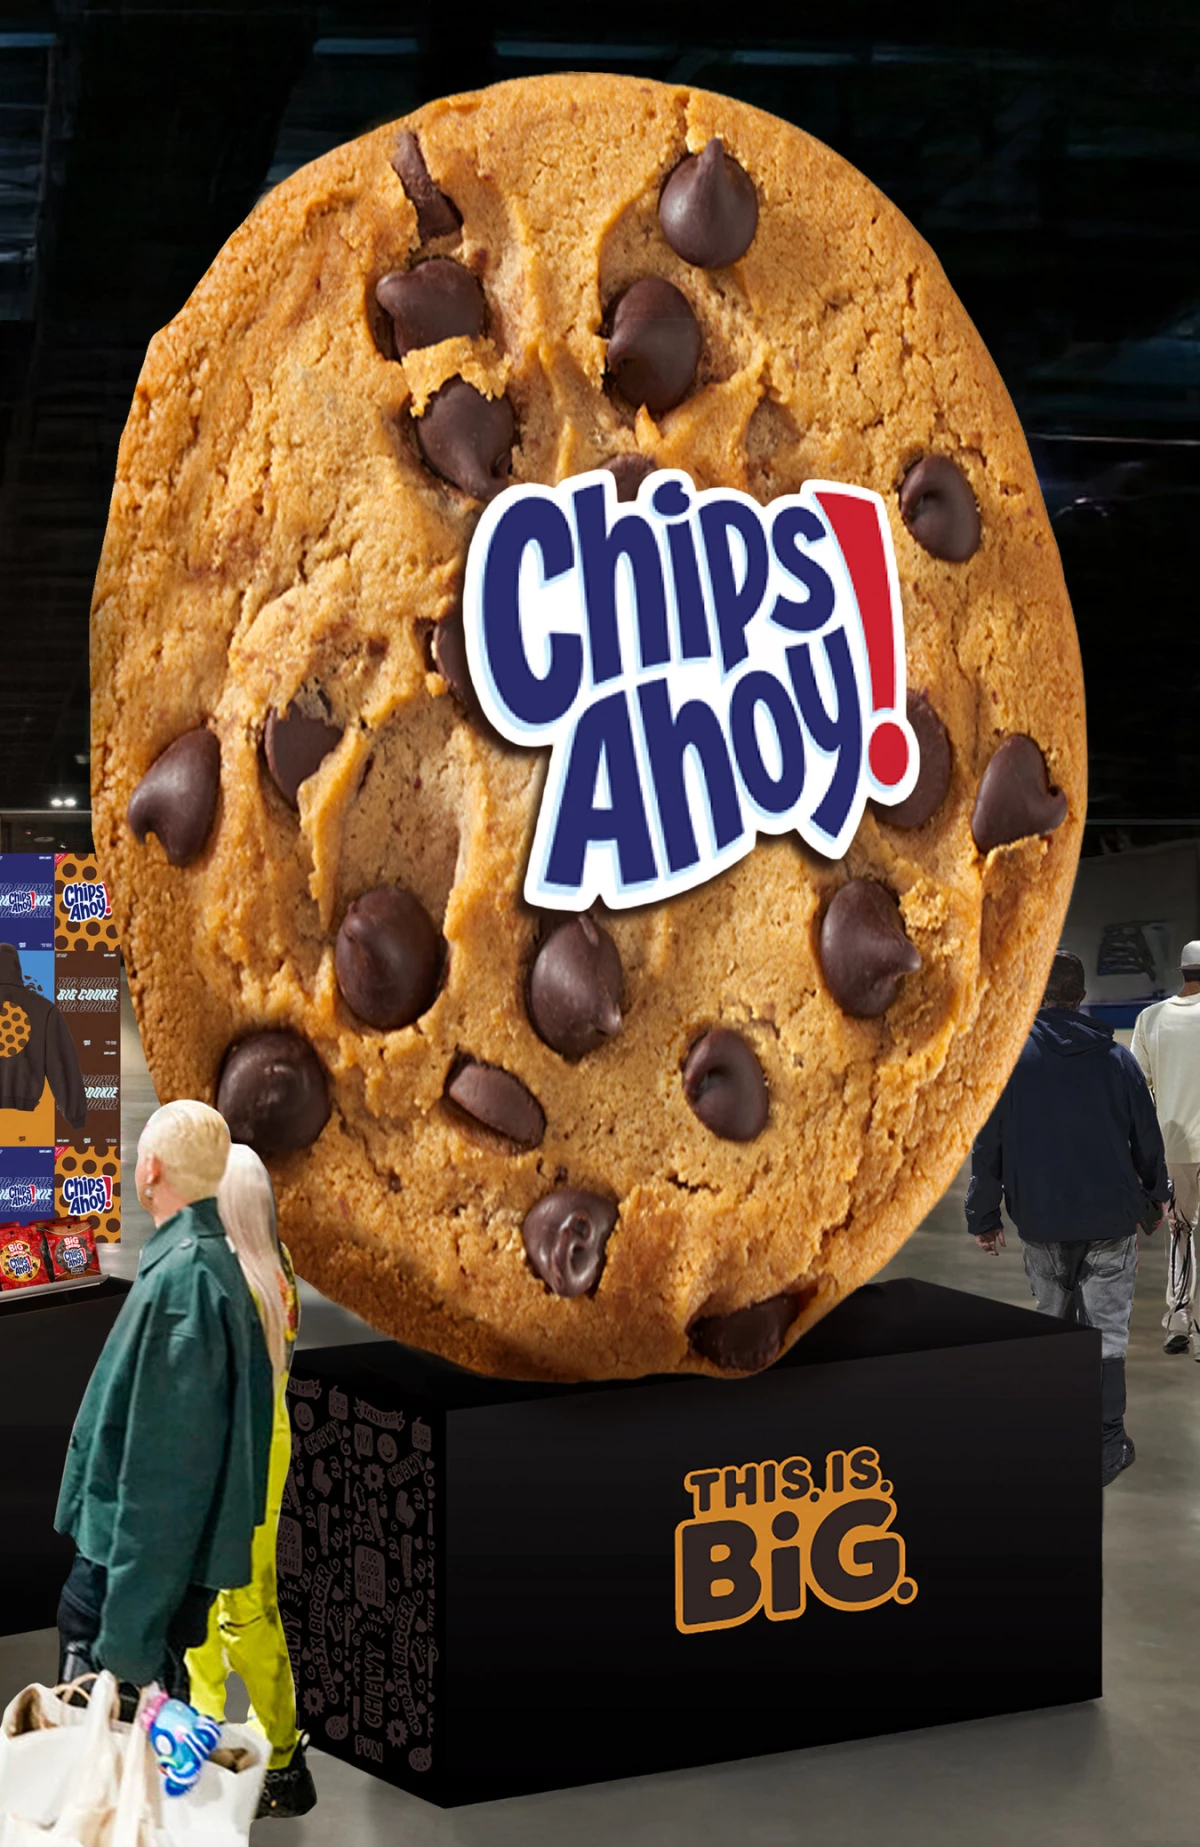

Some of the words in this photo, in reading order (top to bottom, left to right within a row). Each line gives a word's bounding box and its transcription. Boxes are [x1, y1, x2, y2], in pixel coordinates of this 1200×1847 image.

[483, 484, 835, 725] Chips
[543, 491, 910, 888] Ahoy!
[9, 892, 31, 905] Chips
[64, 883, 104, 906] Chips
[57, 989, 77, 1001] BIG
[78, 989, 119, 1001] COOKIE
[9, 1186, 31, 1198] Chips
[64, 1176, 104, 1200] Chips
[69, 1176, 112, 1214] Ahoy!
[9, 1256, 28, 1270] Chips
[63, 1249, 82, 1262] Chips
[690, 1459, 820, 1512] THIS.
[832, 1449, 891, 1496] IS.
[681, 1497, 914, 1626] BiG.
[354, 1734, 384, 1764] FUN
